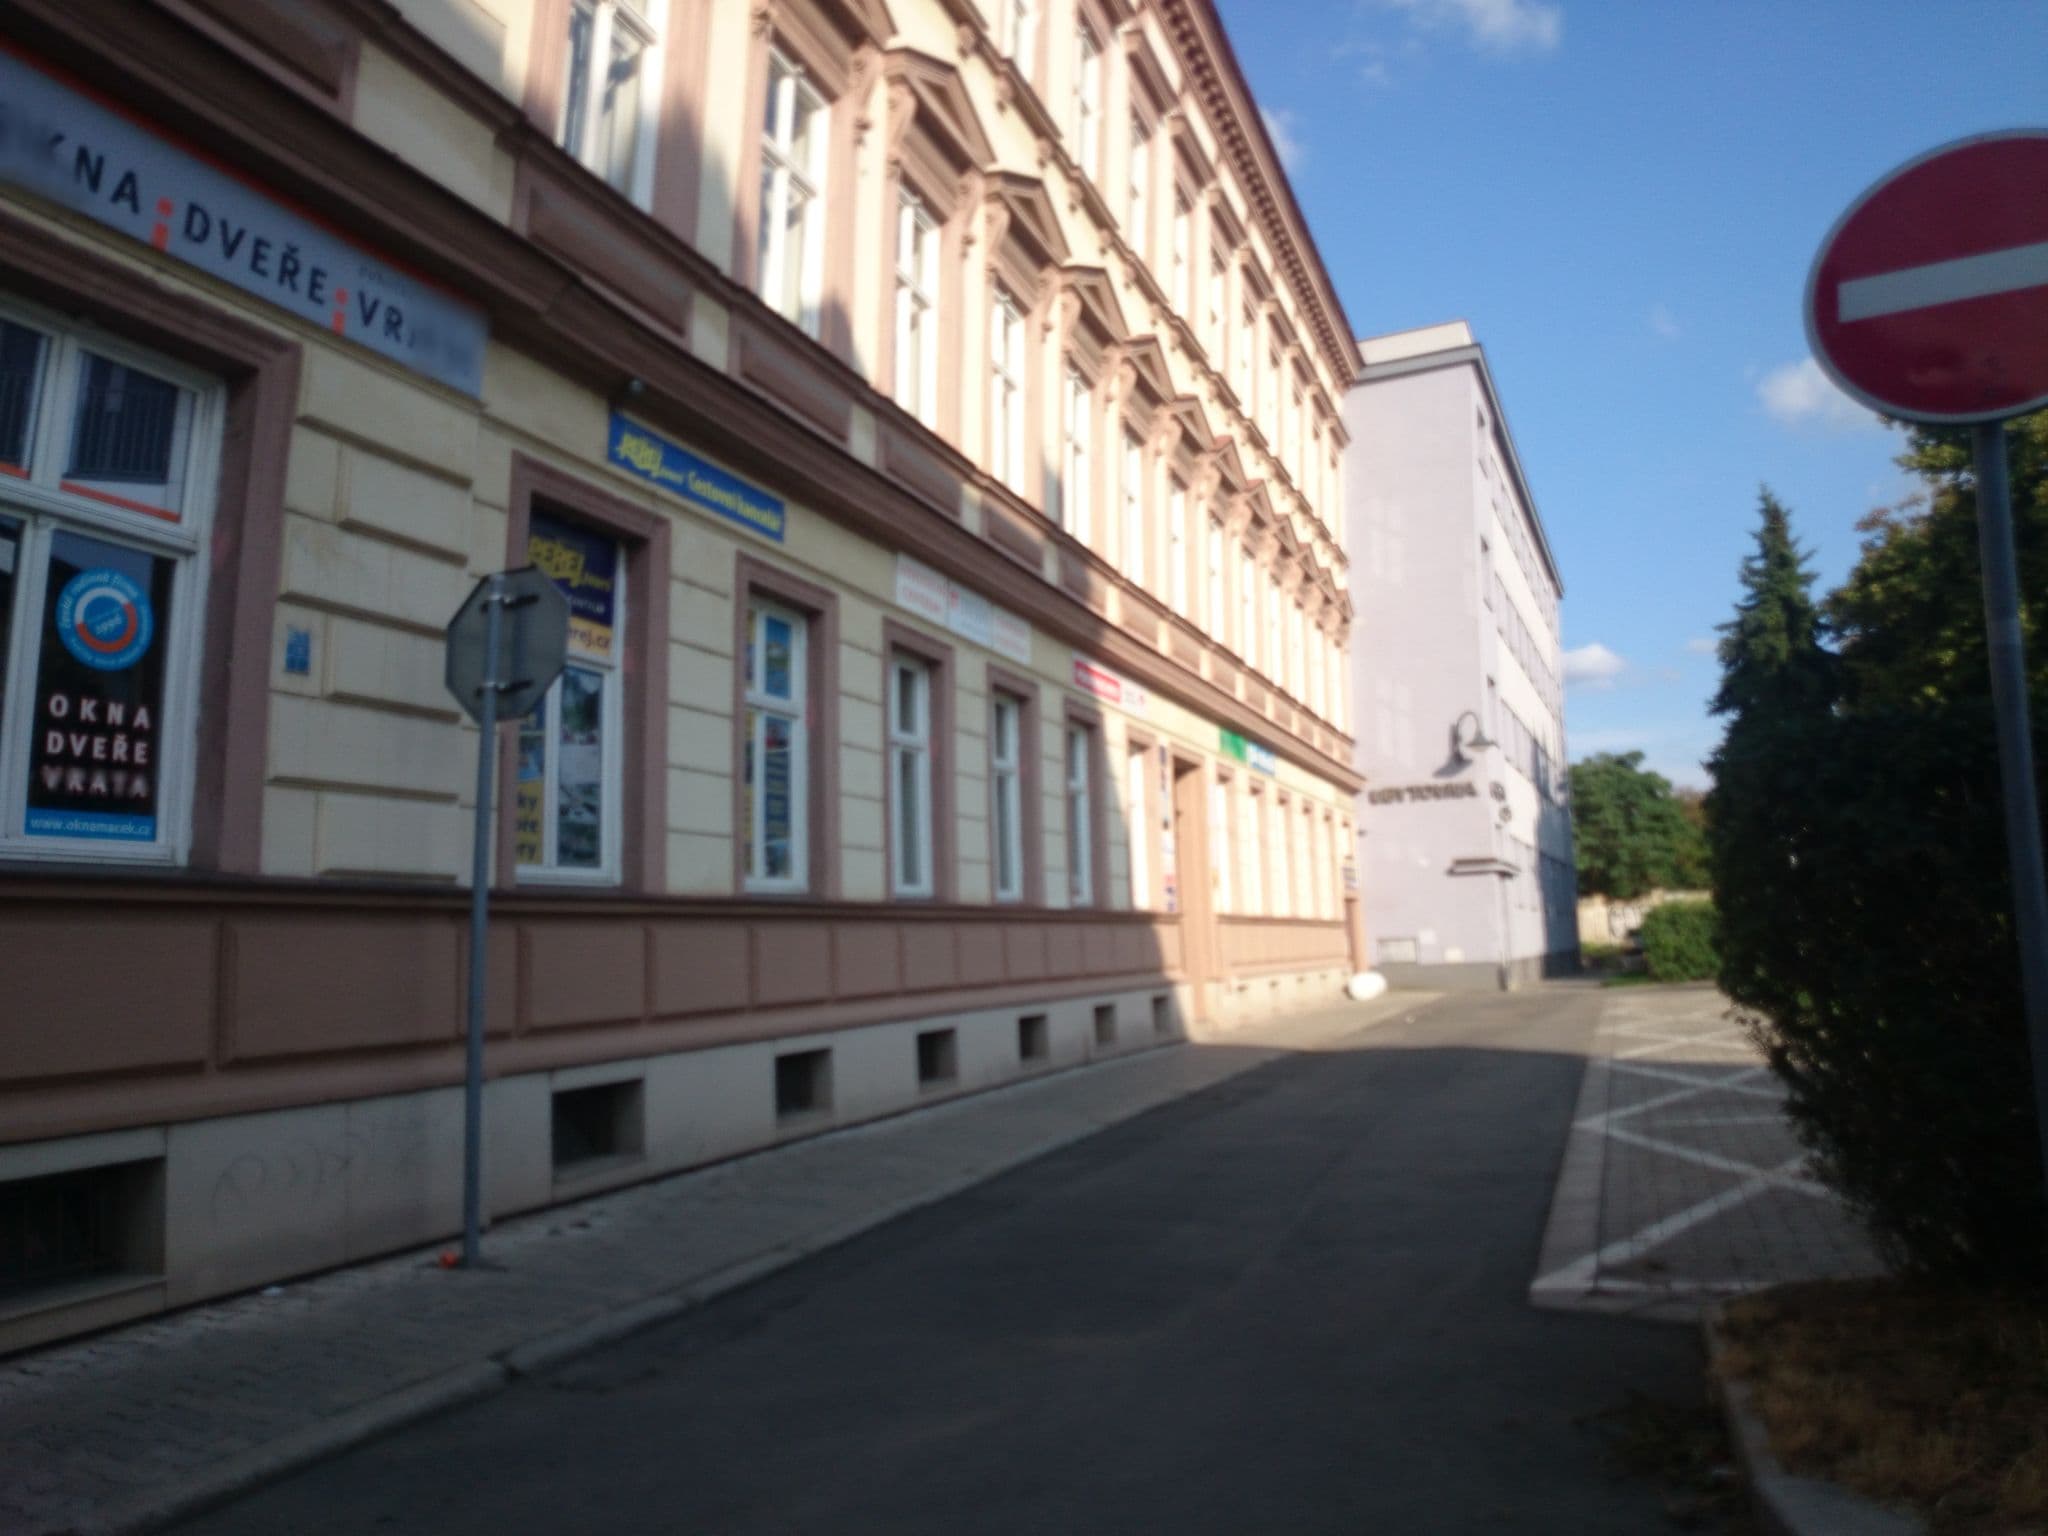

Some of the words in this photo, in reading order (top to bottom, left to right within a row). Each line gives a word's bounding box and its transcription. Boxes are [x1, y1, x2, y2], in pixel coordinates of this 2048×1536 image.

[183, 202, 327, 303] DVEŘE
[50, 694, 150, 729] OKNA
[46, 731, 149, 764] DVEŘE
